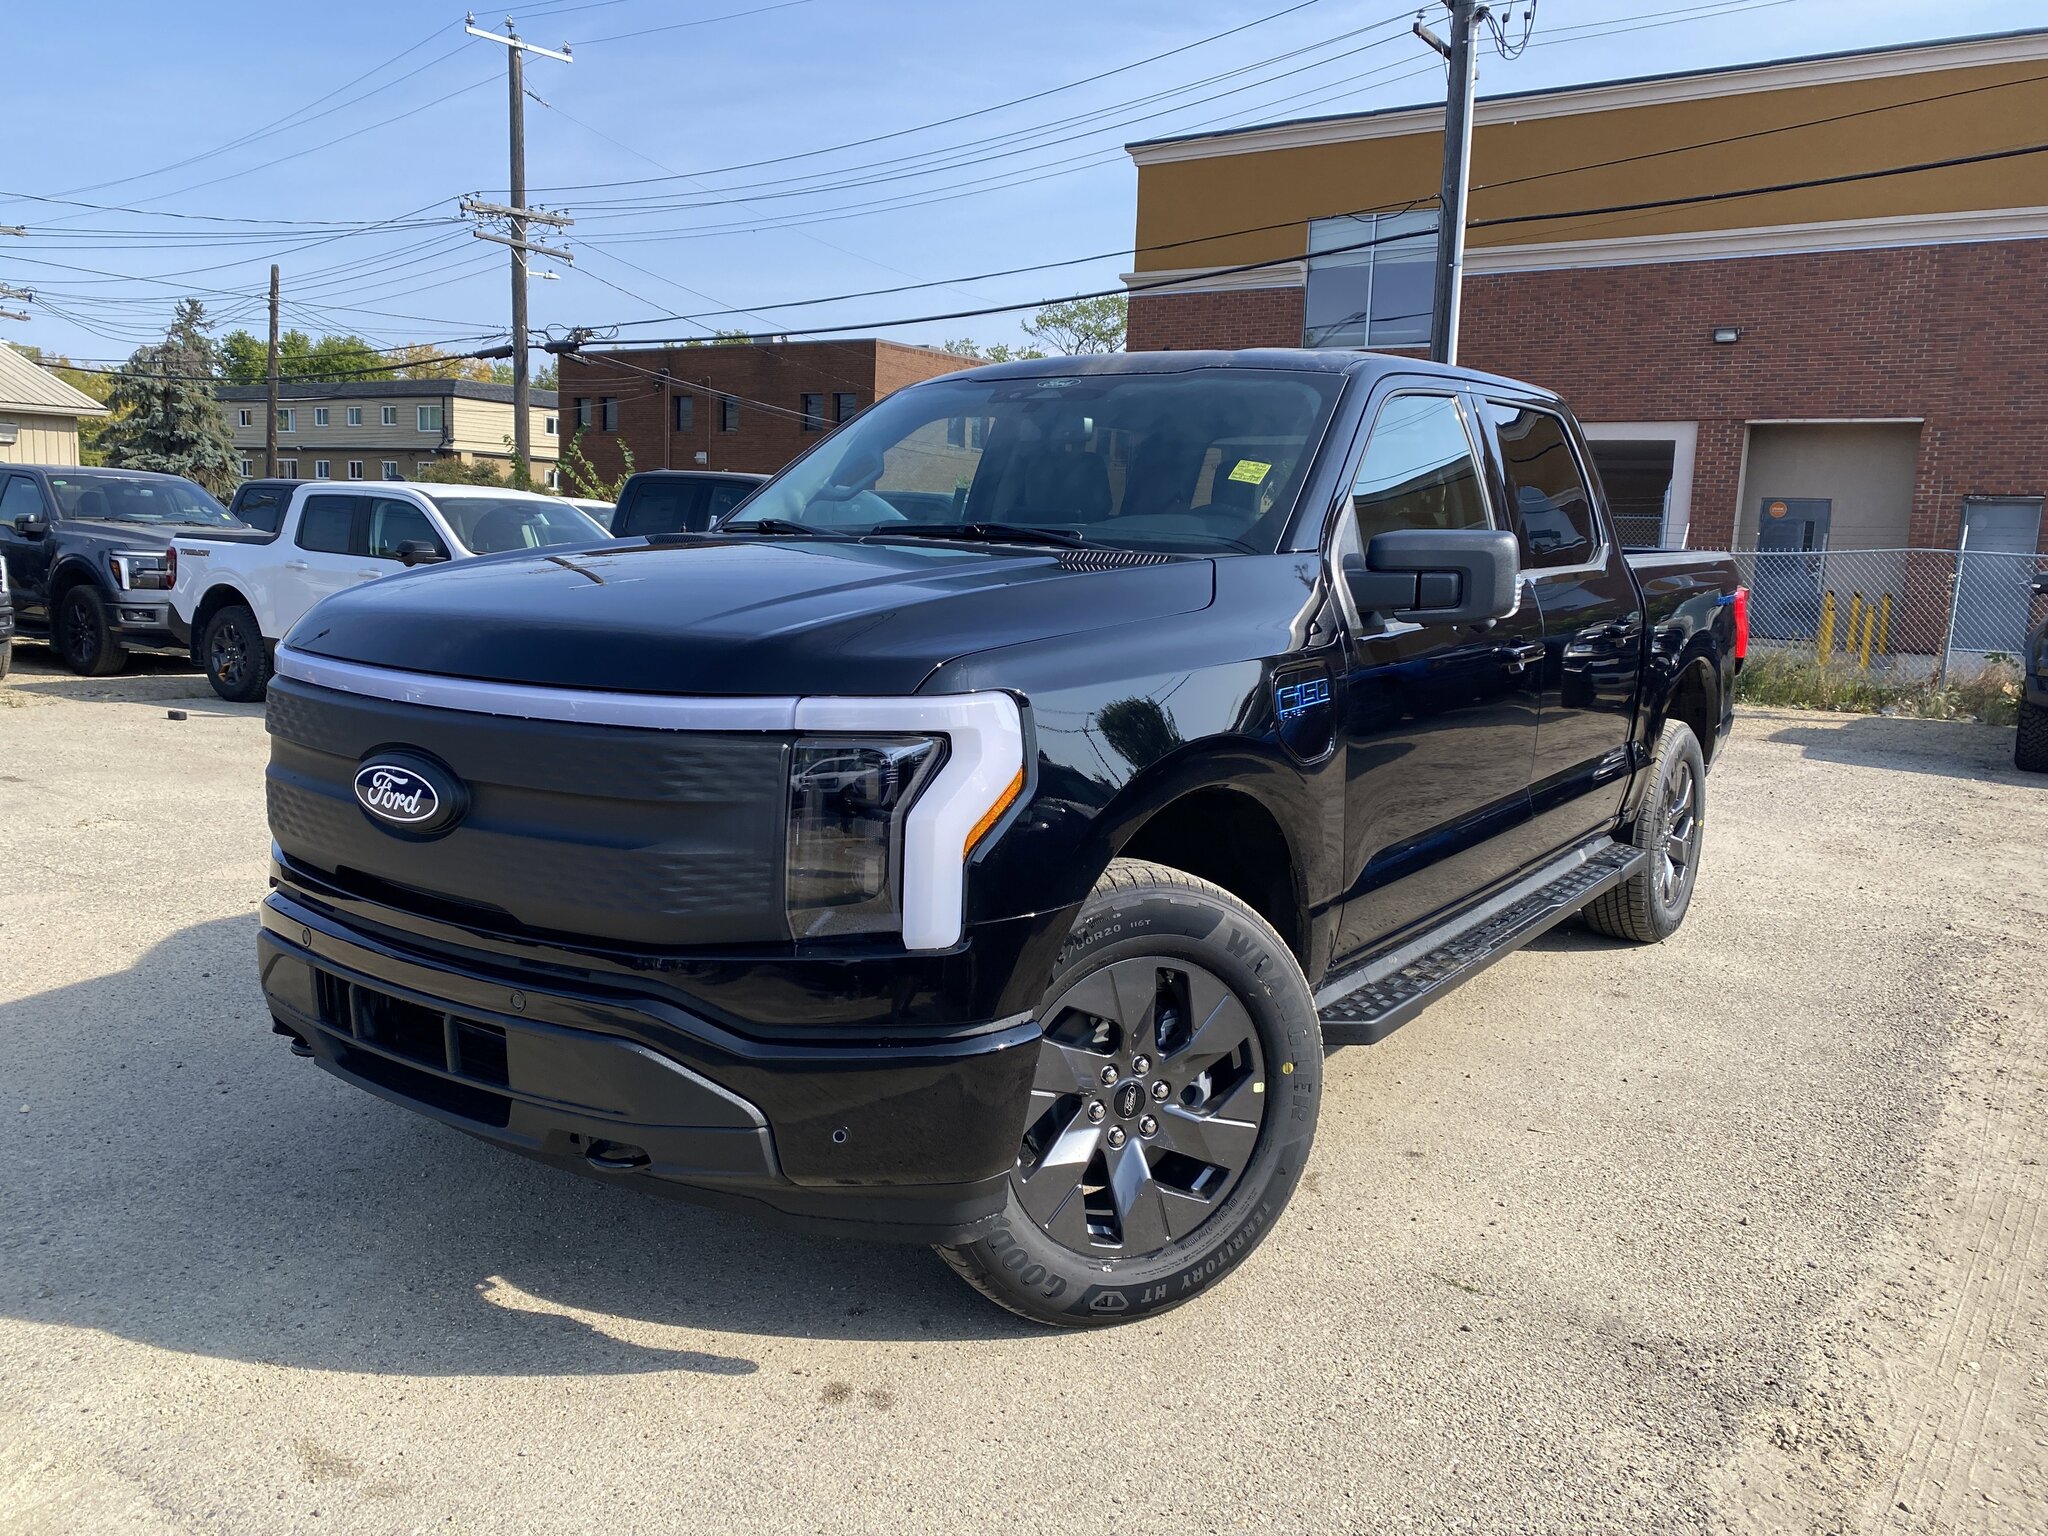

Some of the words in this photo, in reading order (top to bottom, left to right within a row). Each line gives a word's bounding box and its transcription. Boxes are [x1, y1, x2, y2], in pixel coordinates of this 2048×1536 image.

[368, 771, 422, 814] Ford
[1130, 919, 1151, 928] 116T
[1225, 928, 1313, 1121] WRANGLER
[1181, 1201, 1271, 1290] TERRITORY
[1140, 1284, 1167, 1303] HT
